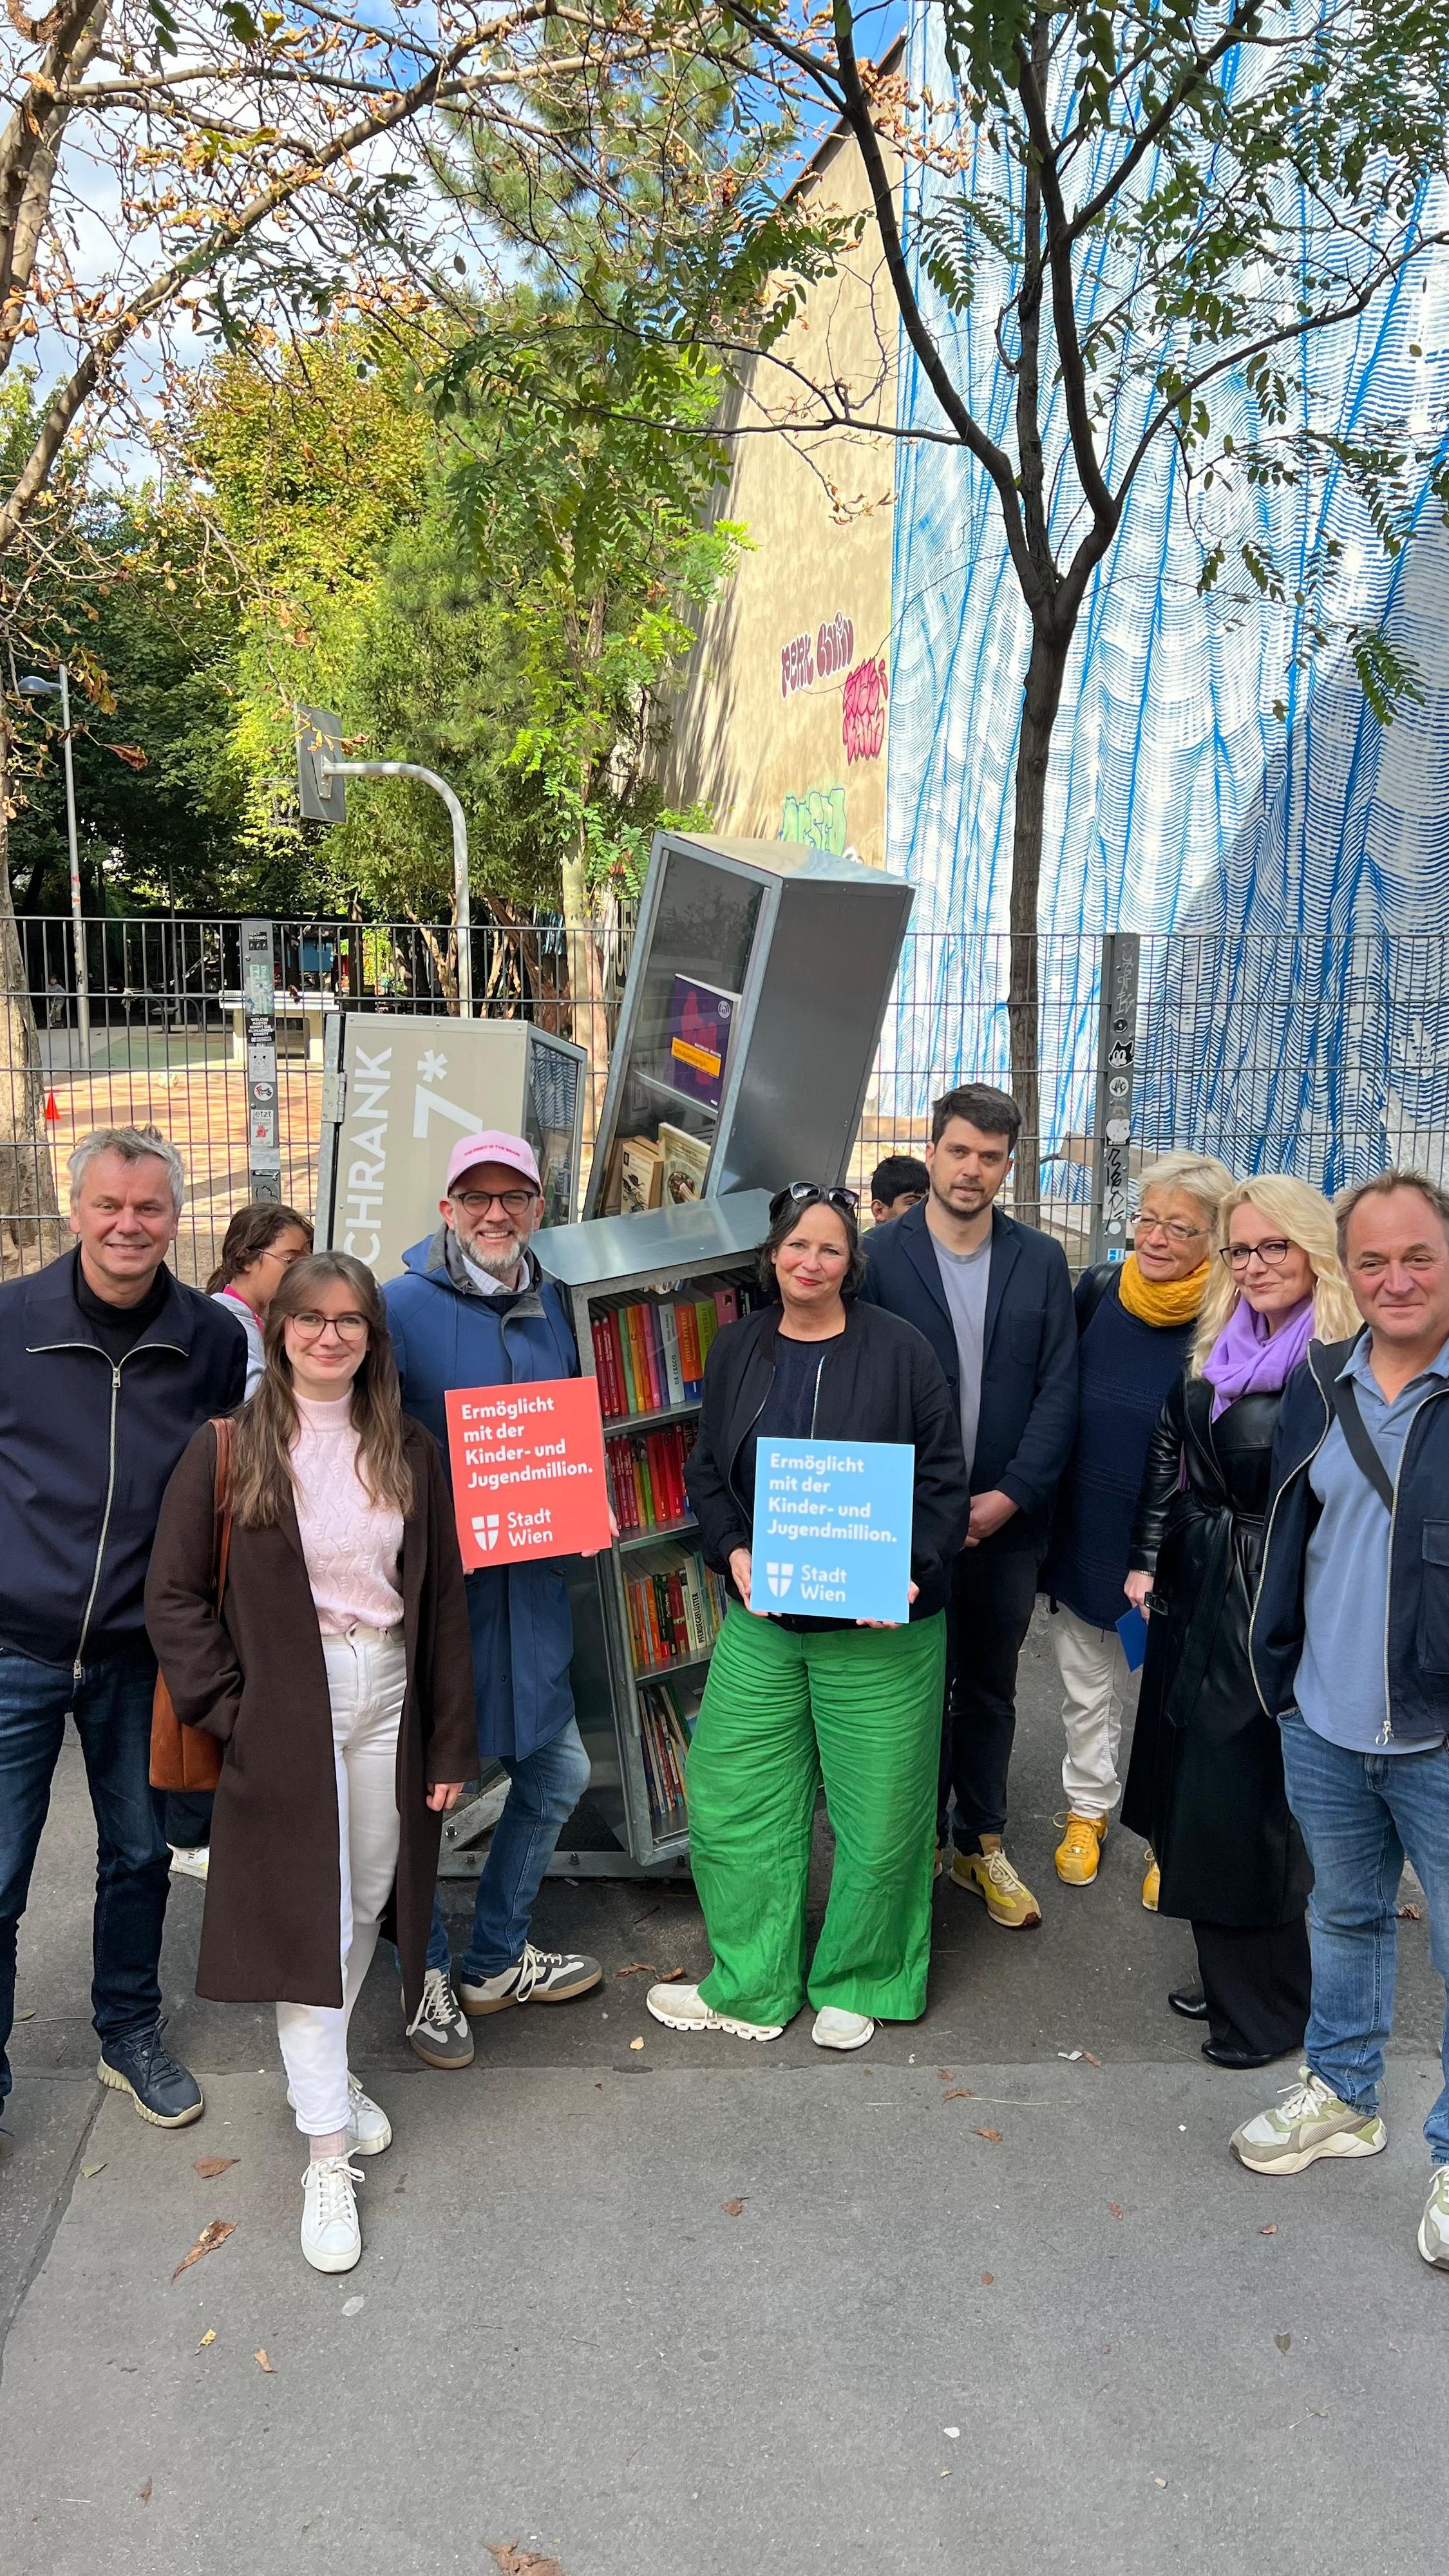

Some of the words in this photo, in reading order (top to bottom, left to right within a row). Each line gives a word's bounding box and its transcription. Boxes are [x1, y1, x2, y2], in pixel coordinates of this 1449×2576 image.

[253, 1110, 271, 1119] jetzt
[674, 1374, 679, 1385] DE
[461, 1396, 554, 1421] Ermöglicht
[464, 1426, 493, 1443] mit
[497, 1423, 524, 1439] der
[465, 1446, 531, 1466] Kinder-
[535, 1439, 565, 1457] und
[770, 1453, 864, 1475] Ermöglicht
[468, 1461, 593, 1490] Jugendmillion.
[769, 1477, 797, 1492] mit
[801, 1476, 831, 1493] der
[768, 1497, 833, 1515] Kinder-
[838, 1502, 871, 1518] und
[507, 1508, 551, 1528] Stadt
[508, 1530, 553, 1547] Wien
[767, 1519, 897, 1542] Jugendmillion.
[801, 1565, 847, 1584] Stadt
[800, 1584, 846, 1602] Wien
